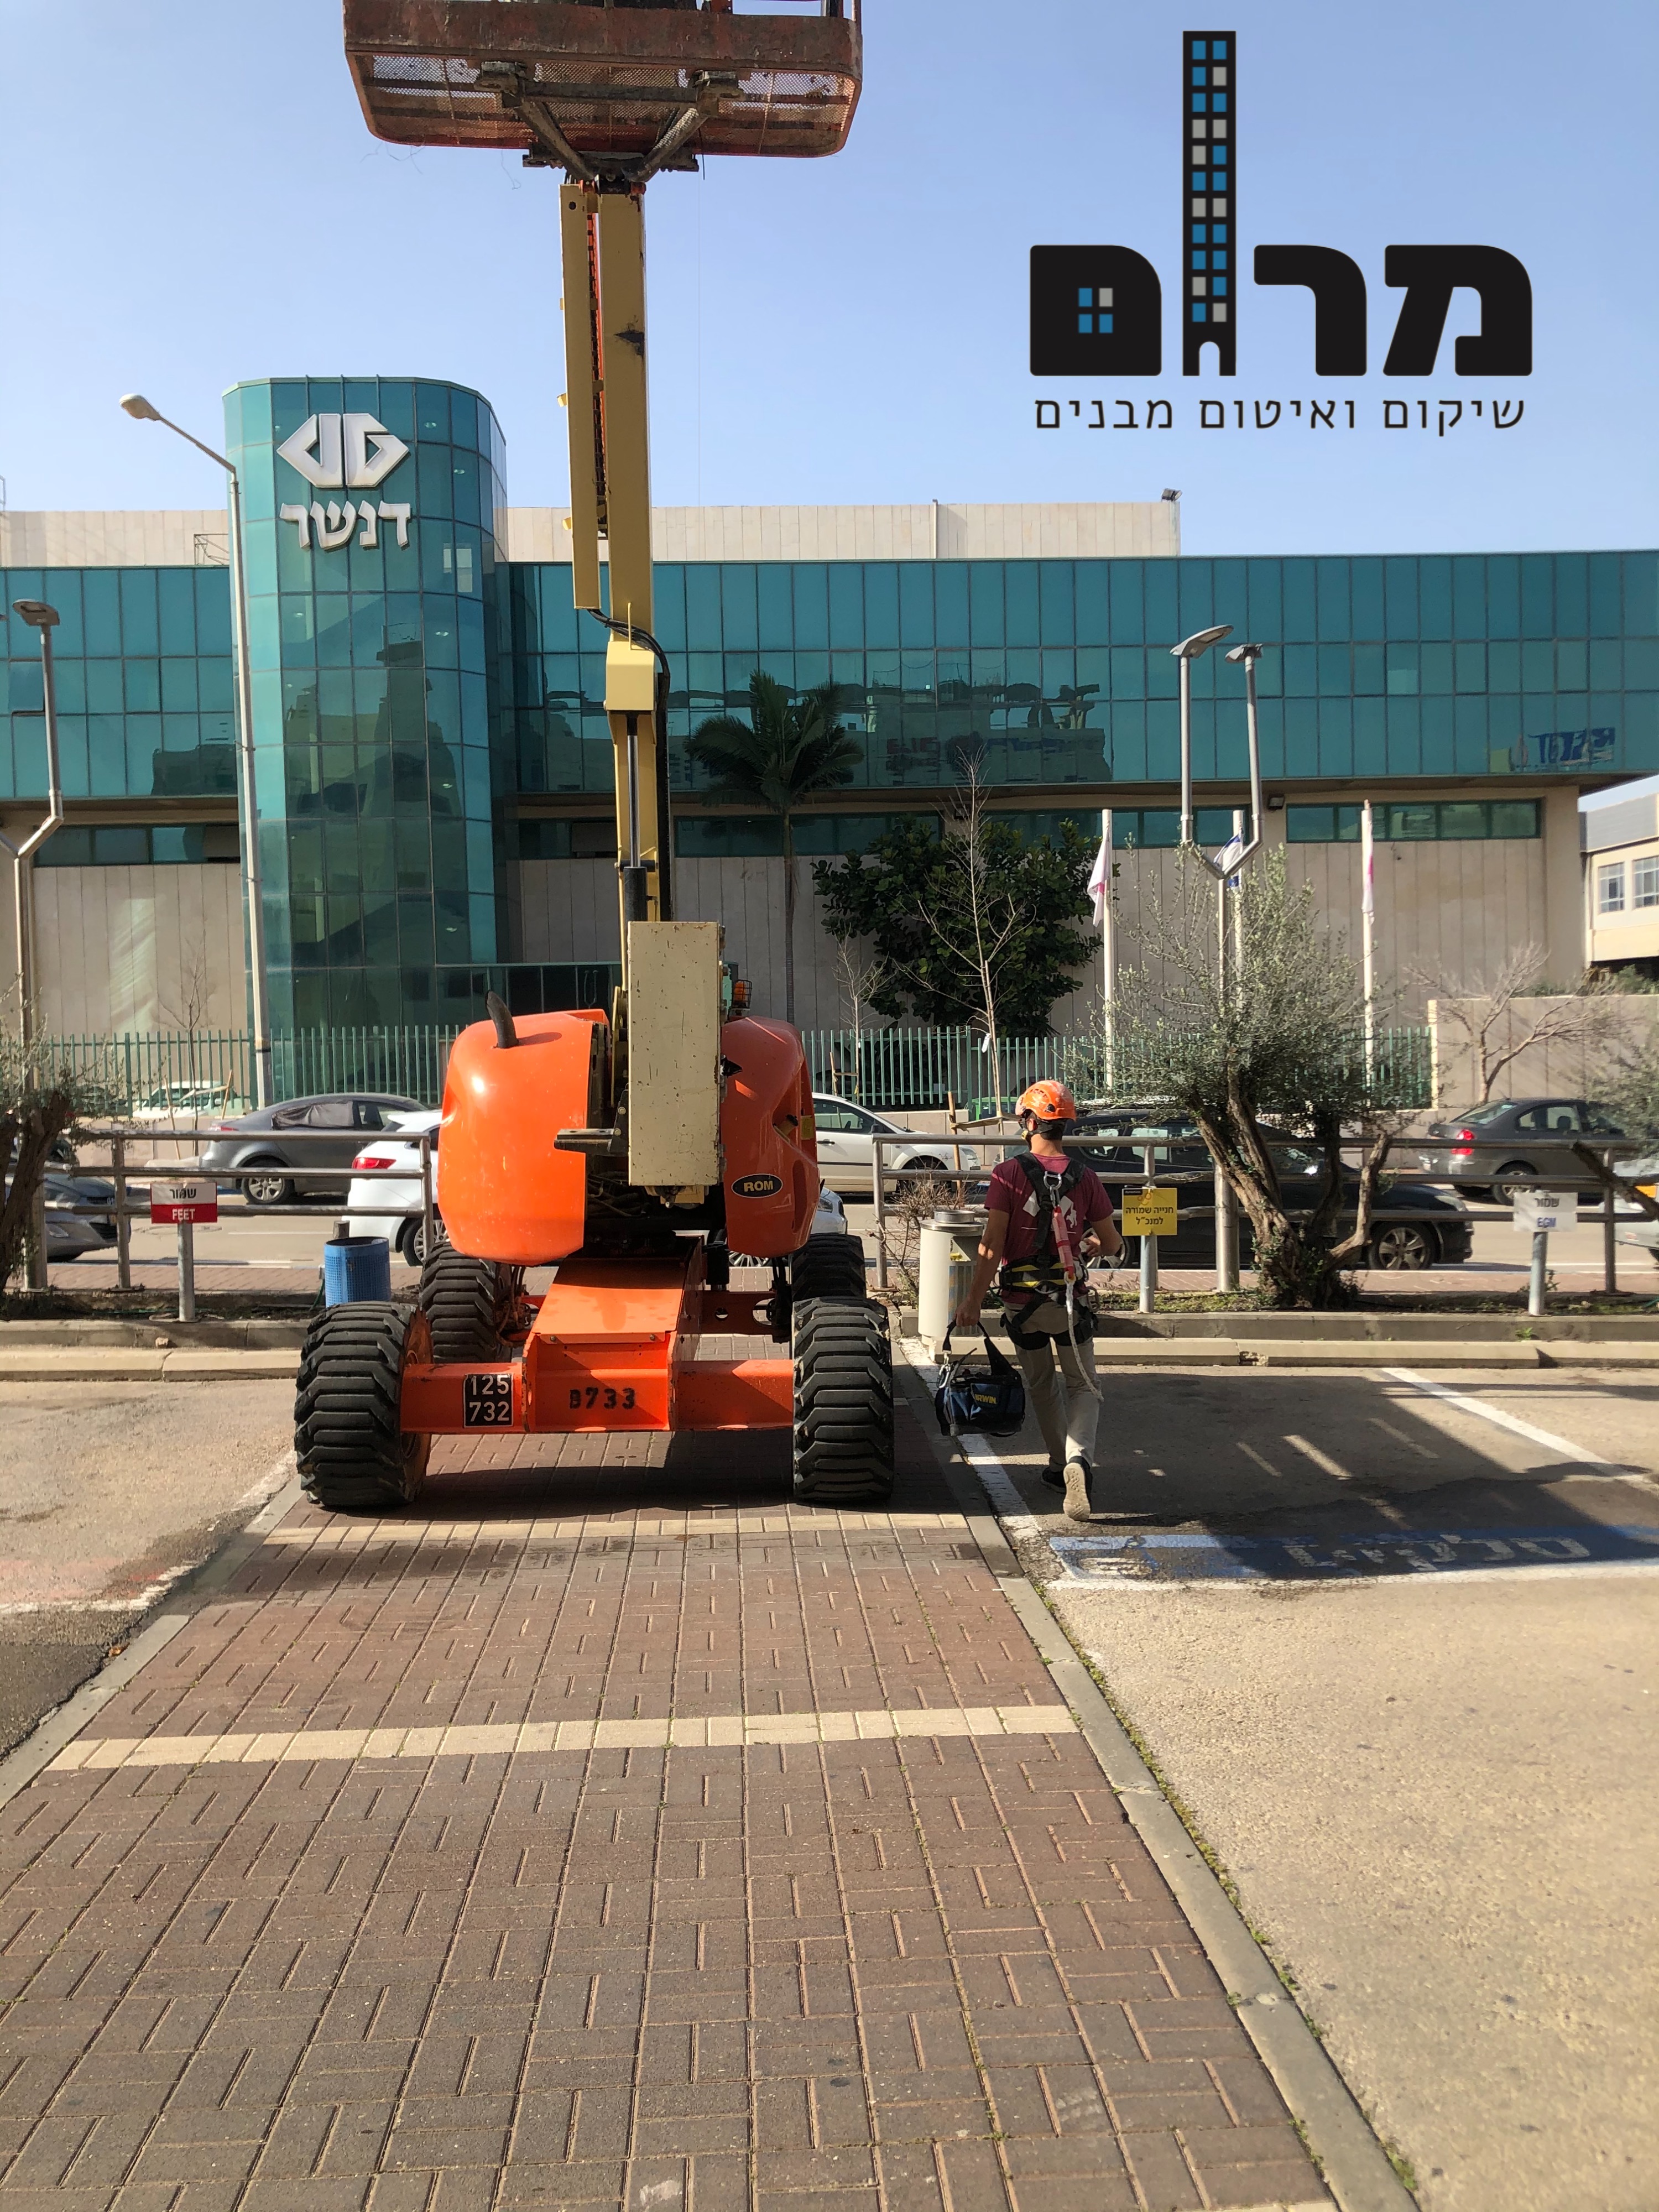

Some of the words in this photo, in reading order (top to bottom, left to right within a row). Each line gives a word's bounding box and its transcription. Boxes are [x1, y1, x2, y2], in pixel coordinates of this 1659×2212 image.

[279, 500, 411, 550] דנשר
[169, 1188, 196, 1199] שמור
[743, 1180, 774, 1192] ROM
[172, 1208, 196, 1220] FEET
[469, 1375, 509, 1395] 125
[569, 1387, 635, 1410] B733
[975, 1394, 997, 1405] IRWIN
[469, 1401, 509, 1422] 732
